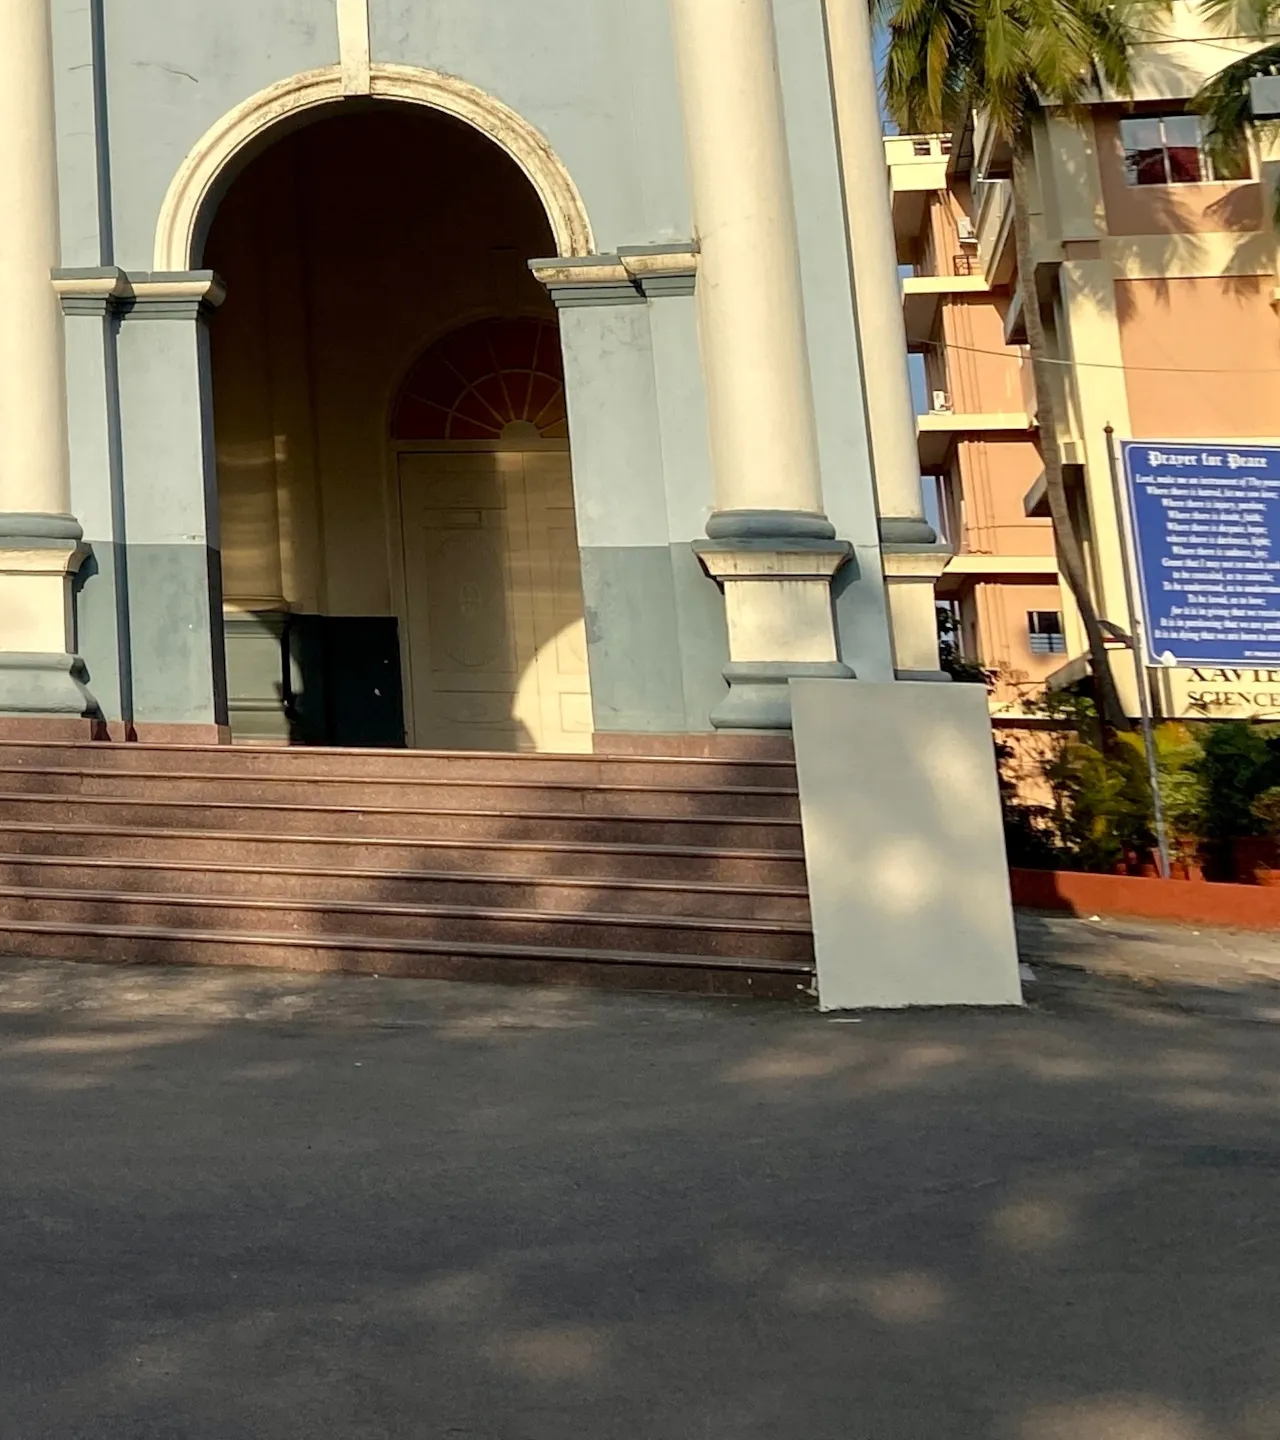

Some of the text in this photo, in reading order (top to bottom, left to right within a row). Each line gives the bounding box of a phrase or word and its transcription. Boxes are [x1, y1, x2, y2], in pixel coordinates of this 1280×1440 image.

[1147, 451, 1268, 470] Prayer for Peace
[1187, 691, 1280, 707] SCIENCE
